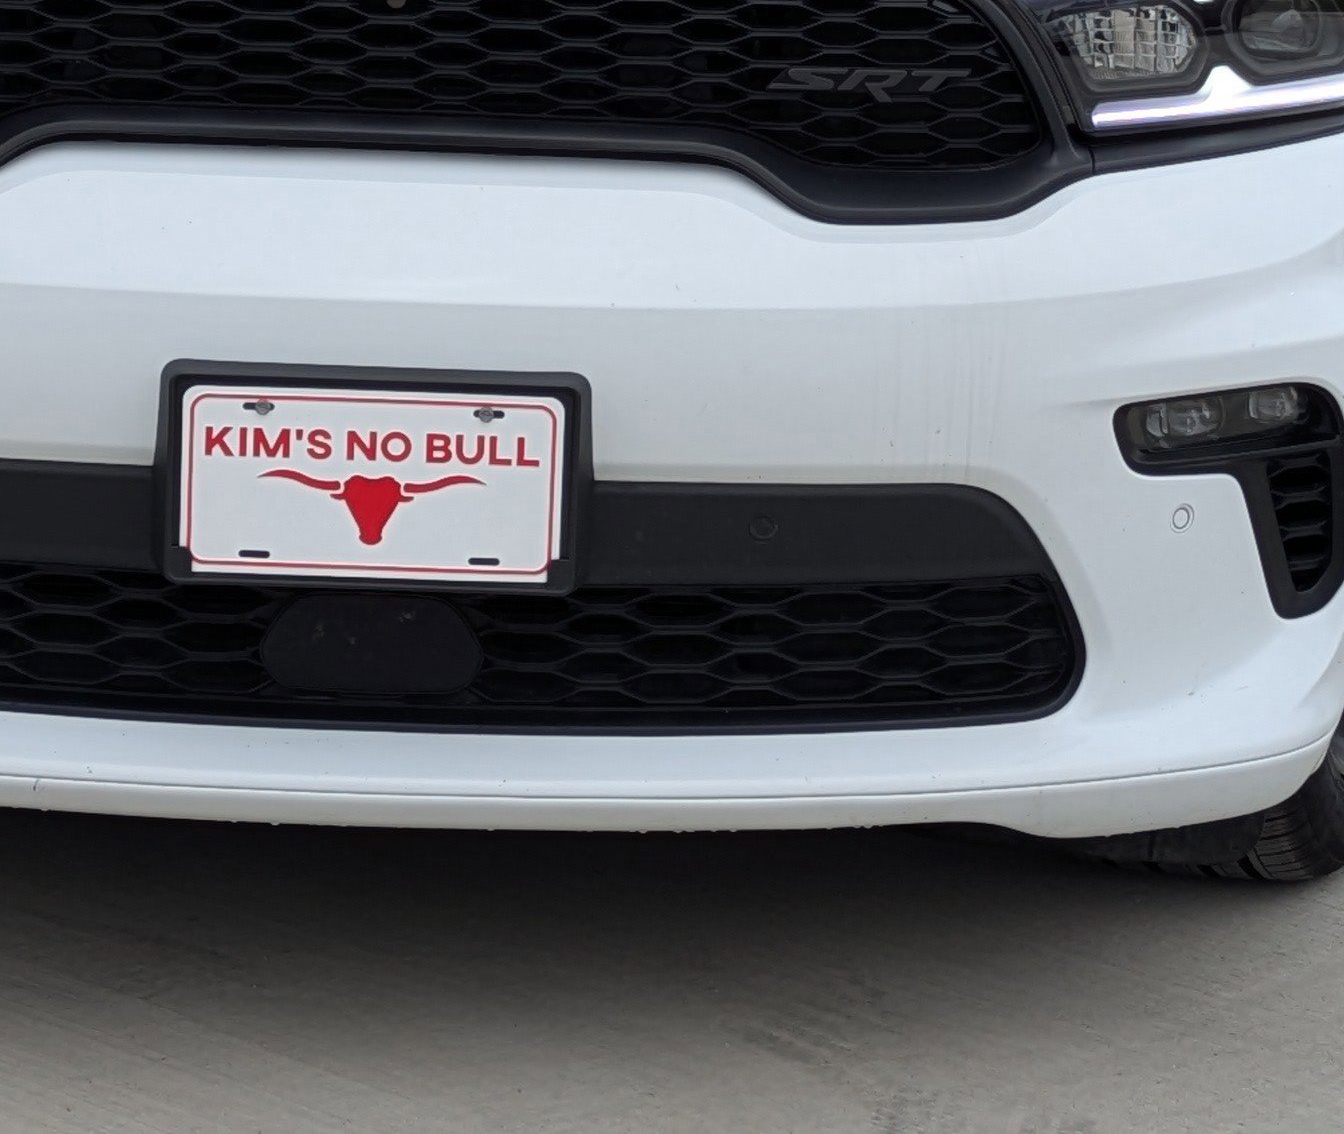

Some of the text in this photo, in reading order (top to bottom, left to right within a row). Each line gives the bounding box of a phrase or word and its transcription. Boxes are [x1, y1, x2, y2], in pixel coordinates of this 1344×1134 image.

[766, 67, 972, 103] SRT
[203, 426, 541, 468] KIM'S NO BULL
